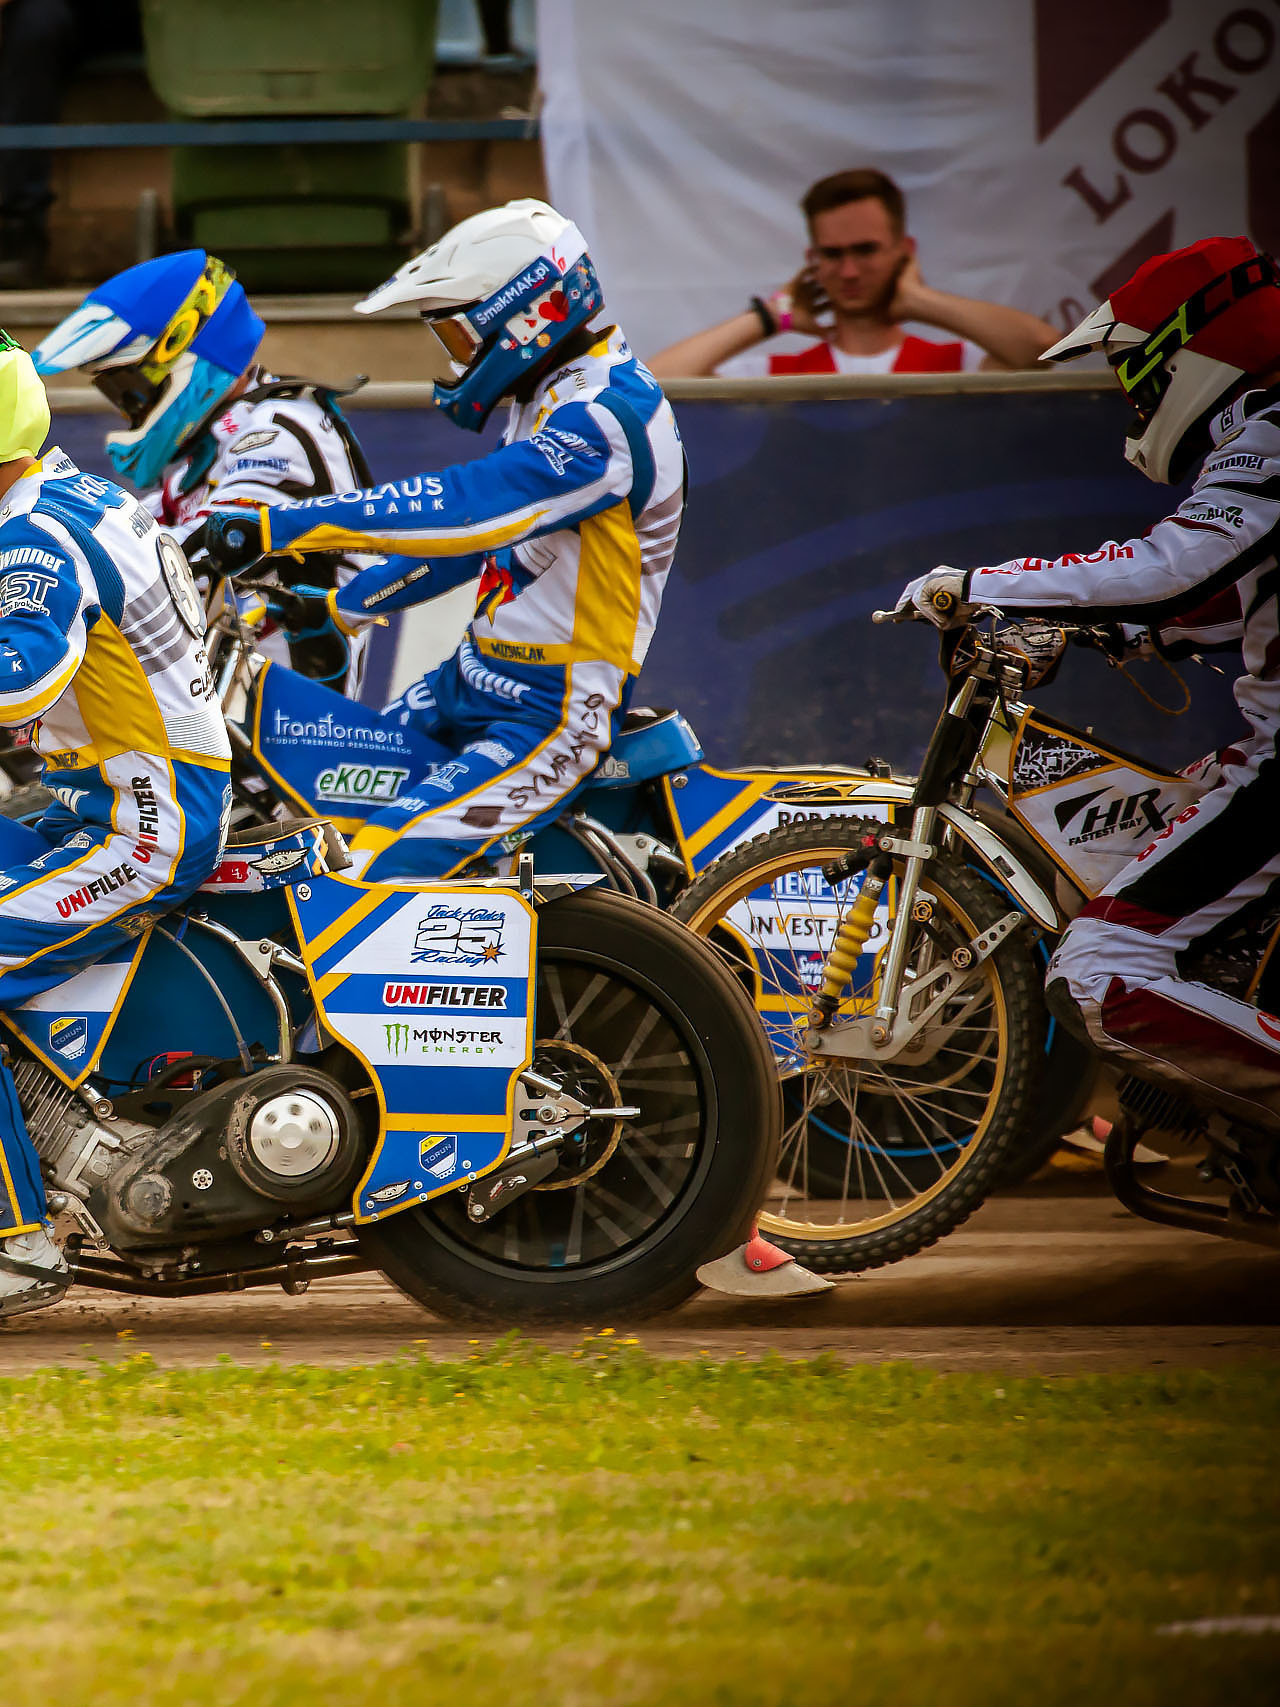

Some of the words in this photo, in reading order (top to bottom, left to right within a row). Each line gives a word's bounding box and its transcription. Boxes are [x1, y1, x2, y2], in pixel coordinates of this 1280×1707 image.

[476, 262, 551, 325] SmakMAK.pl
[364, 499, 445, 516] BANK
[275, 709, 404, 745] transformers
[319, 767, 408, 797] eKOFT
[131, 775, 160, 864] UNIFILTER
[1068, 825, 1118, 846] FASTEST
[1119, 816, 1144, 831] WAY
[55, 862, 141, 919] UNIFILTE
[427, 904, 462, 918] Jack
[460, 908, 506, 921] Holder
[414, 916, 505, 955] 25
[410, 950, 487, 968] Racing
[384, 985, 506, 1007] UNIFILTER
[412, 1027, 504, 1044] MONSTER
[421, 1045, 496, 1054] ENERGY
